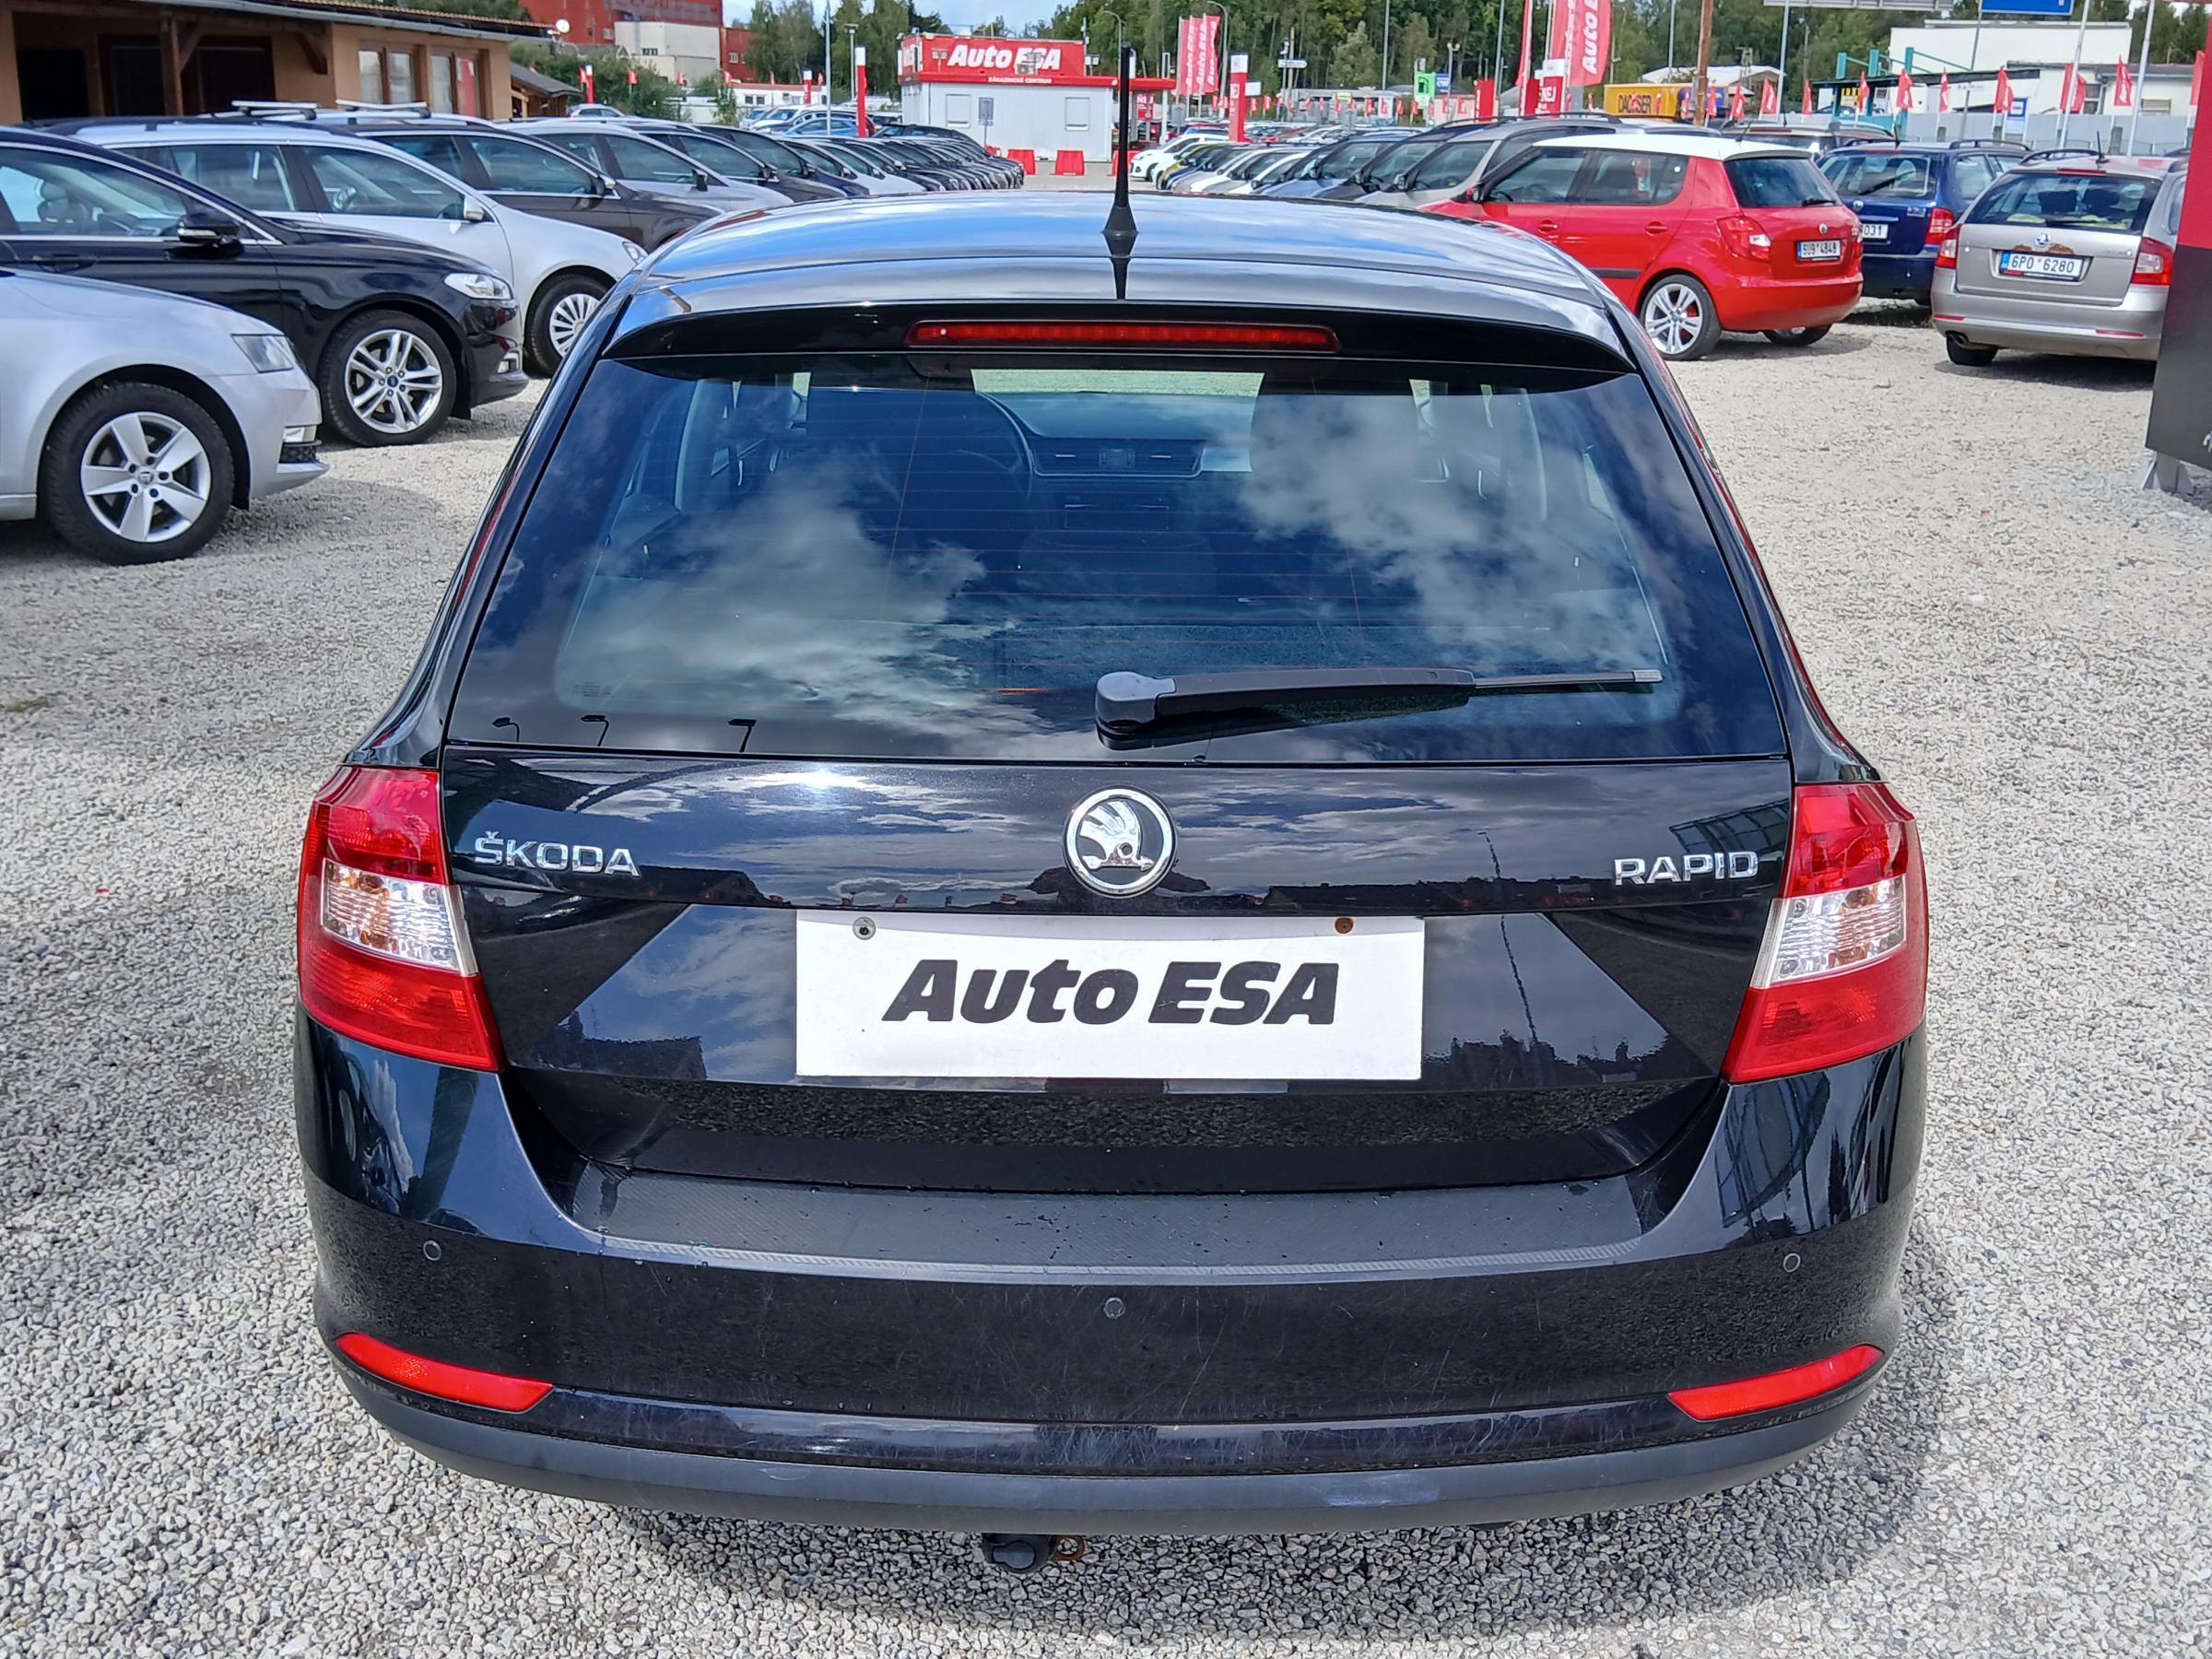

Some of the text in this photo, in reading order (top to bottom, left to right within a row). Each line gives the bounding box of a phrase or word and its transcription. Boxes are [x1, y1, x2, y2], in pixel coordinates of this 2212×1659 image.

[947, 44, 1012, 69] Auto
[1582, 11, 1598, 75] Auto
[2042, 258, 2075, 273] 6280
[475, 831, 641, 877] ŠKODA
[1614, 851, 1759, 886] RAPID
[882, 959, 1339, 1025] Auto ESA
